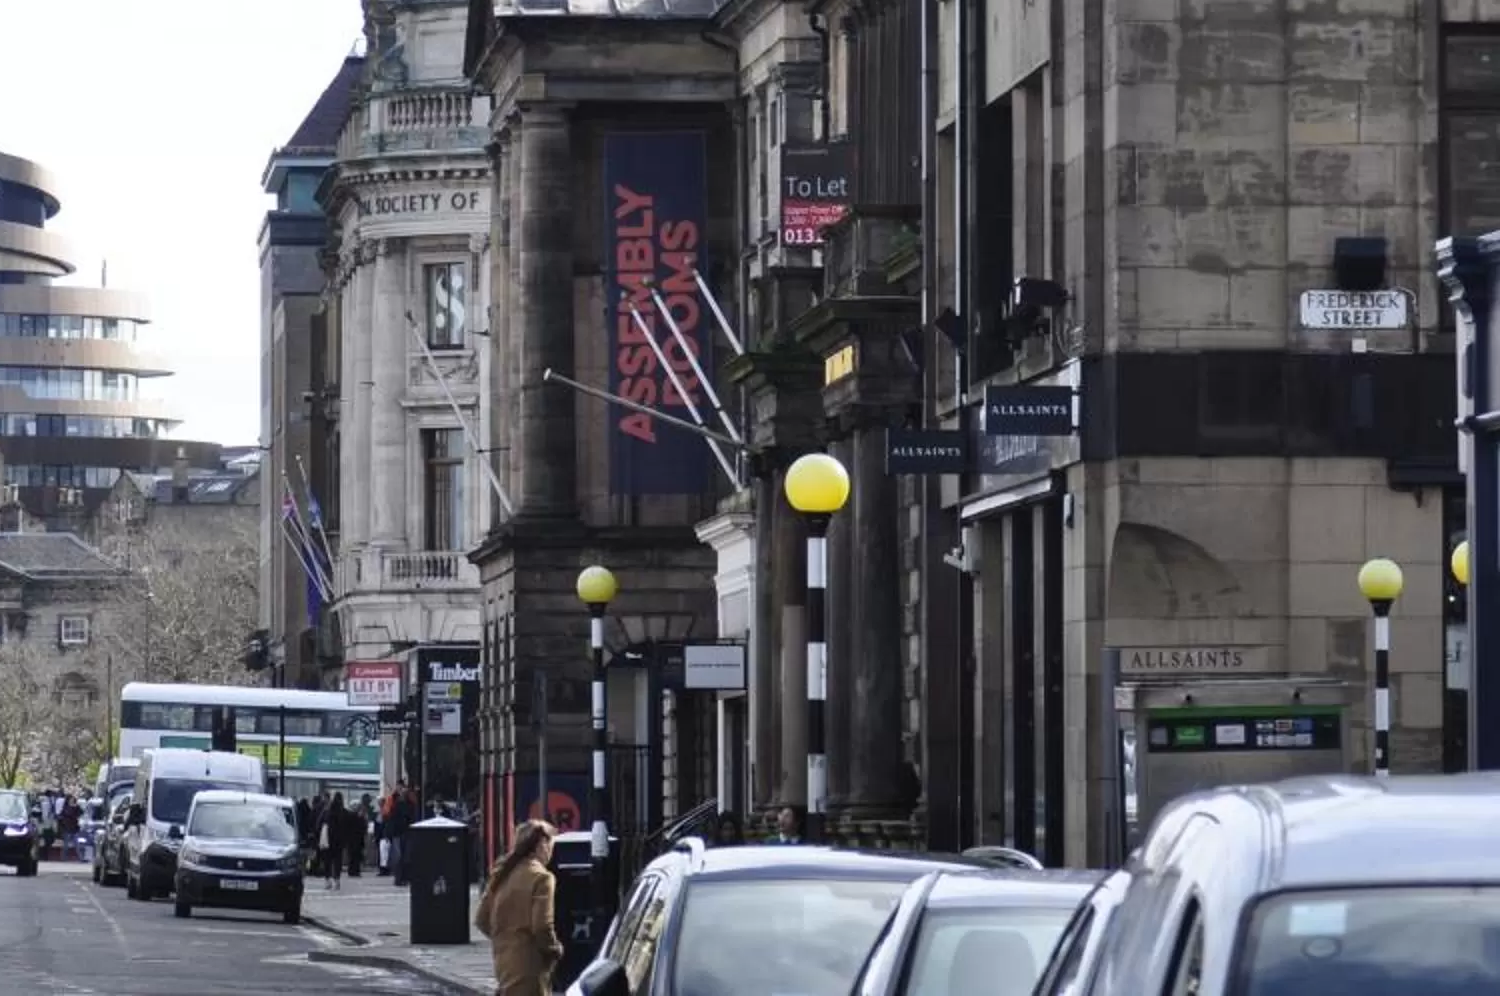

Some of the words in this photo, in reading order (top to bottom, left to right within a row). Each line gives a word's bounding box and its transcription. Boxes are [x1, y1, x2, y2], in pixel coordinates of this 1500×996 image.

[784, 175, 811, 198] To
[816, 176, 848, 198] Let
[375, 192, 442, 215] SOCIETY
[450, 191, 480, 211] OF
[1307, 292, 1400, 309] FREDERICK
[614, 183, 657, 445] ASSEMBLY
[659, 218, 700, 407] ROOMS
[1321, 309, 1384, 325] STREET
[991, 405, 1068, 416] ALLSAINTS
[1131, 650, 1244, 669] ALLSAINTS
[353, 679, 374, 693] LET
